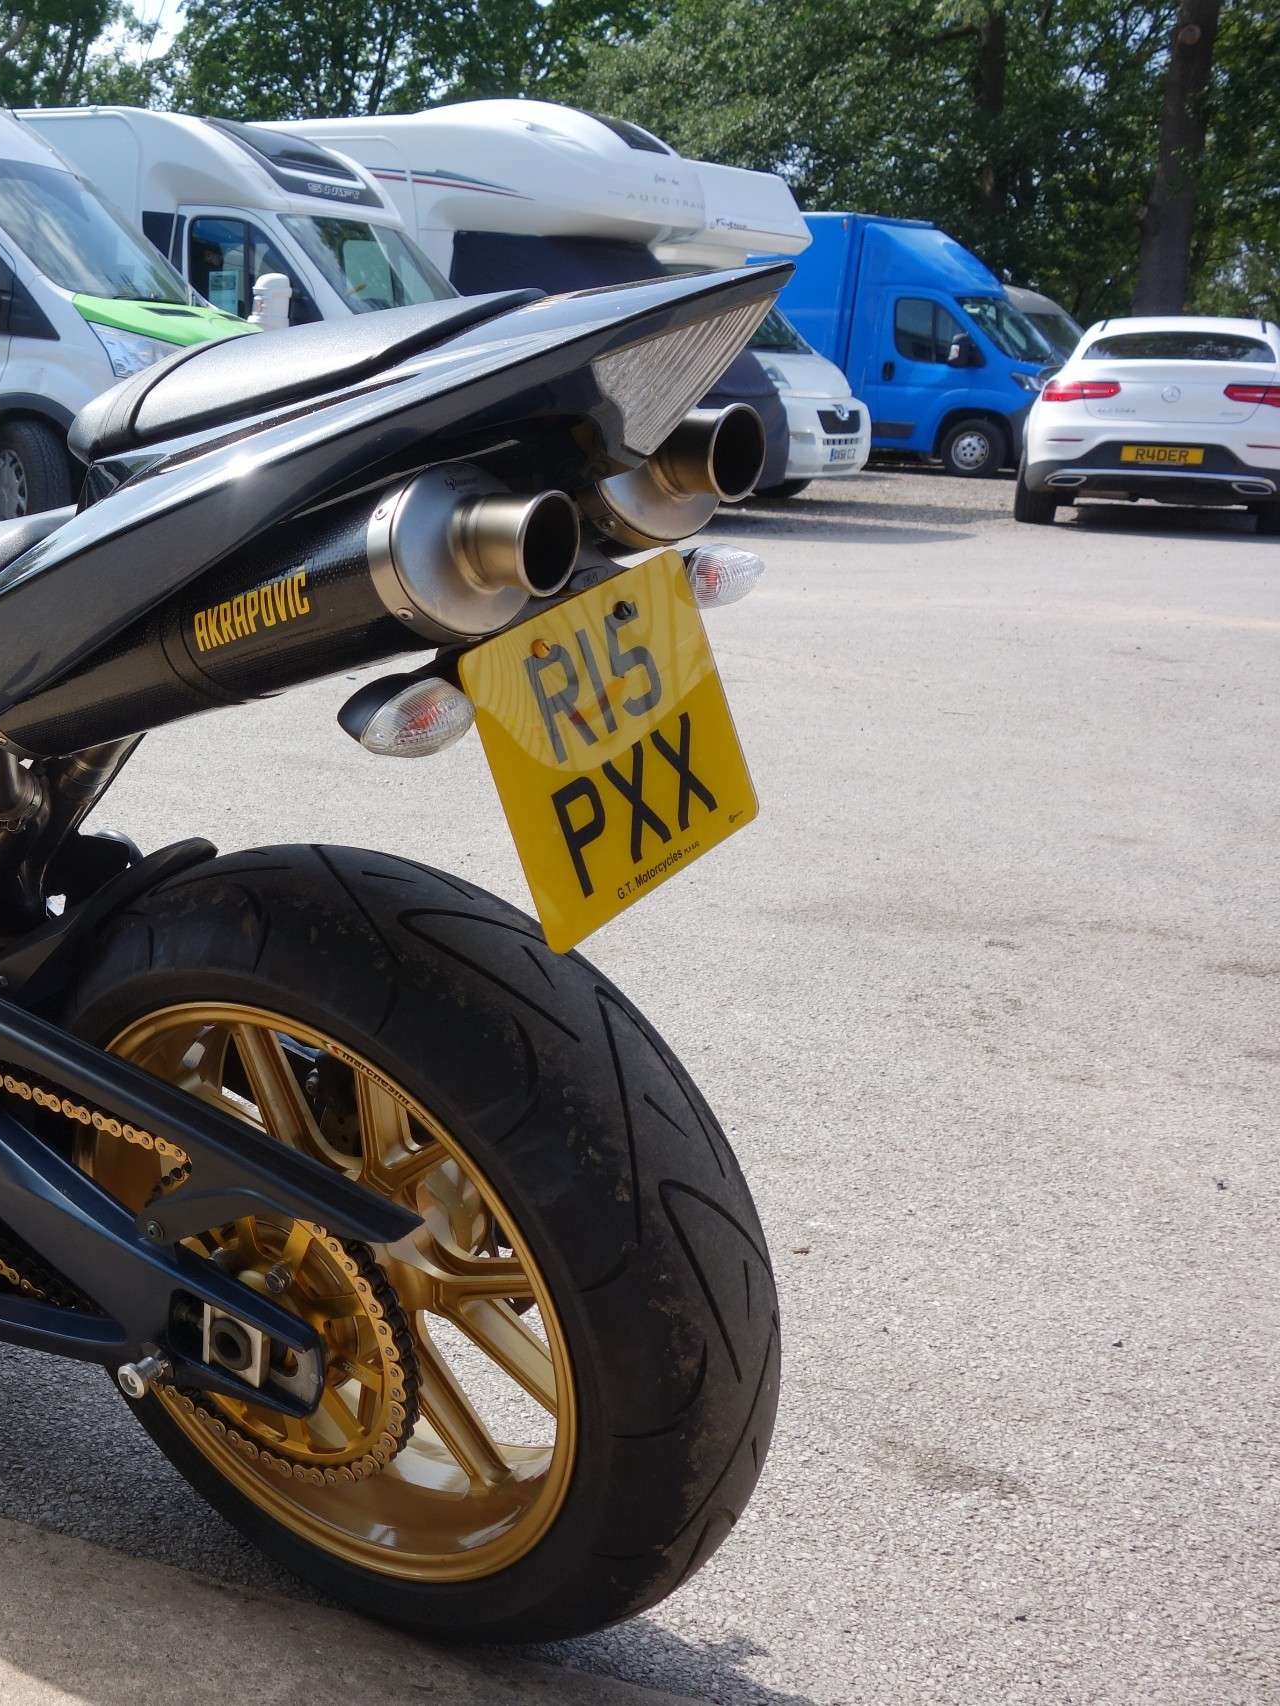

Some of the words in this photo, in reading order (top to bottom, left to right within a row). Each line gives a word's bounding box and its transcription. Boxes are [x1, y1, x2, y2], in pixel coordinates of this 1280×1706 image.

[1135, 447, 1189, 462] R4DER
[524, 601, 663, 764] R15
[551, 711, 718, 898] PXX
[617, 881, 635, 900] G.T.
[634, 848, 683, 888] Motorcycles
